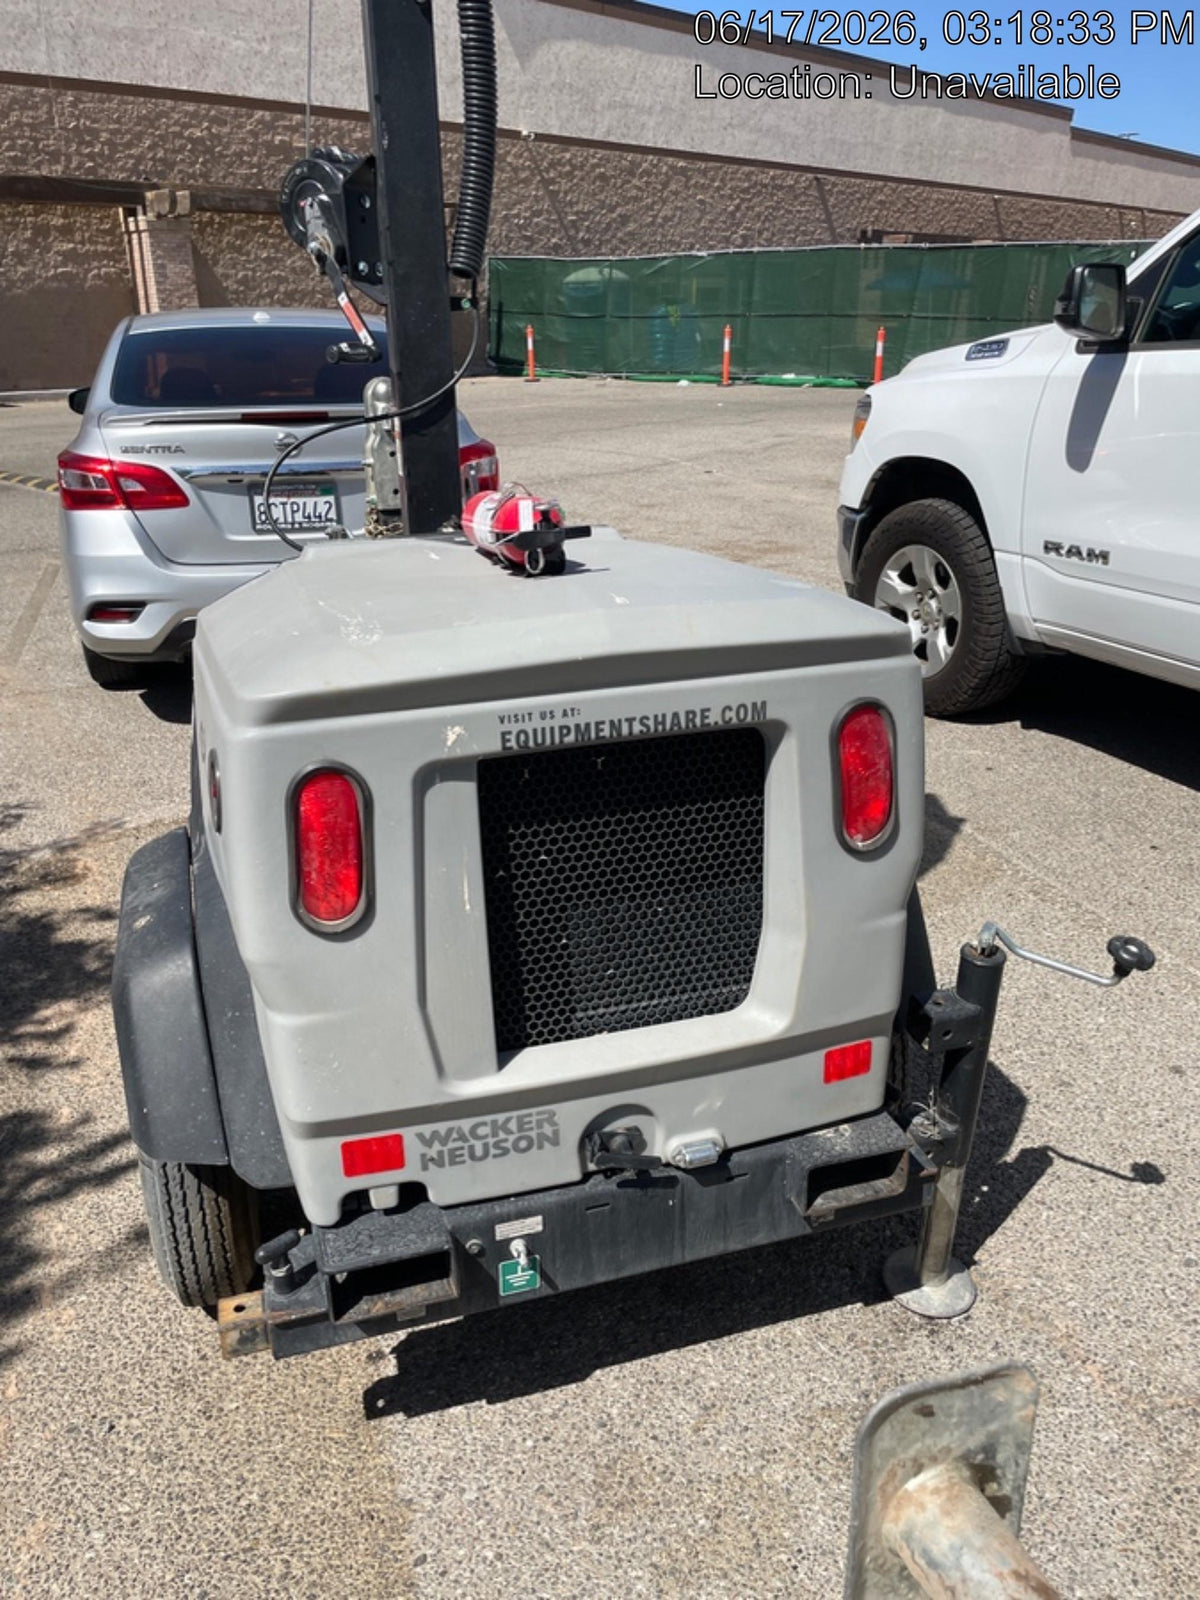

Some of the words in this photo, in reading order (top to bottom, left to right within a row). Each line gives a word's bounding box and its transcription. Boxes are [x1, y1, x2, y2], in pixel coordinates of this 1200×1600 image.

[1043, 540, 1110, 566] RAM
[498, 712, 533, 725] VISIT
[539, 709, 556, 721] US
[561, 706, 581, 719] AT:
[500, 700, 767, 751] EQUIPMENTSHARE.COM
[415, 1109, 560, 1149] WACKER
[420, 1128, 560, 1172] NEUSON
